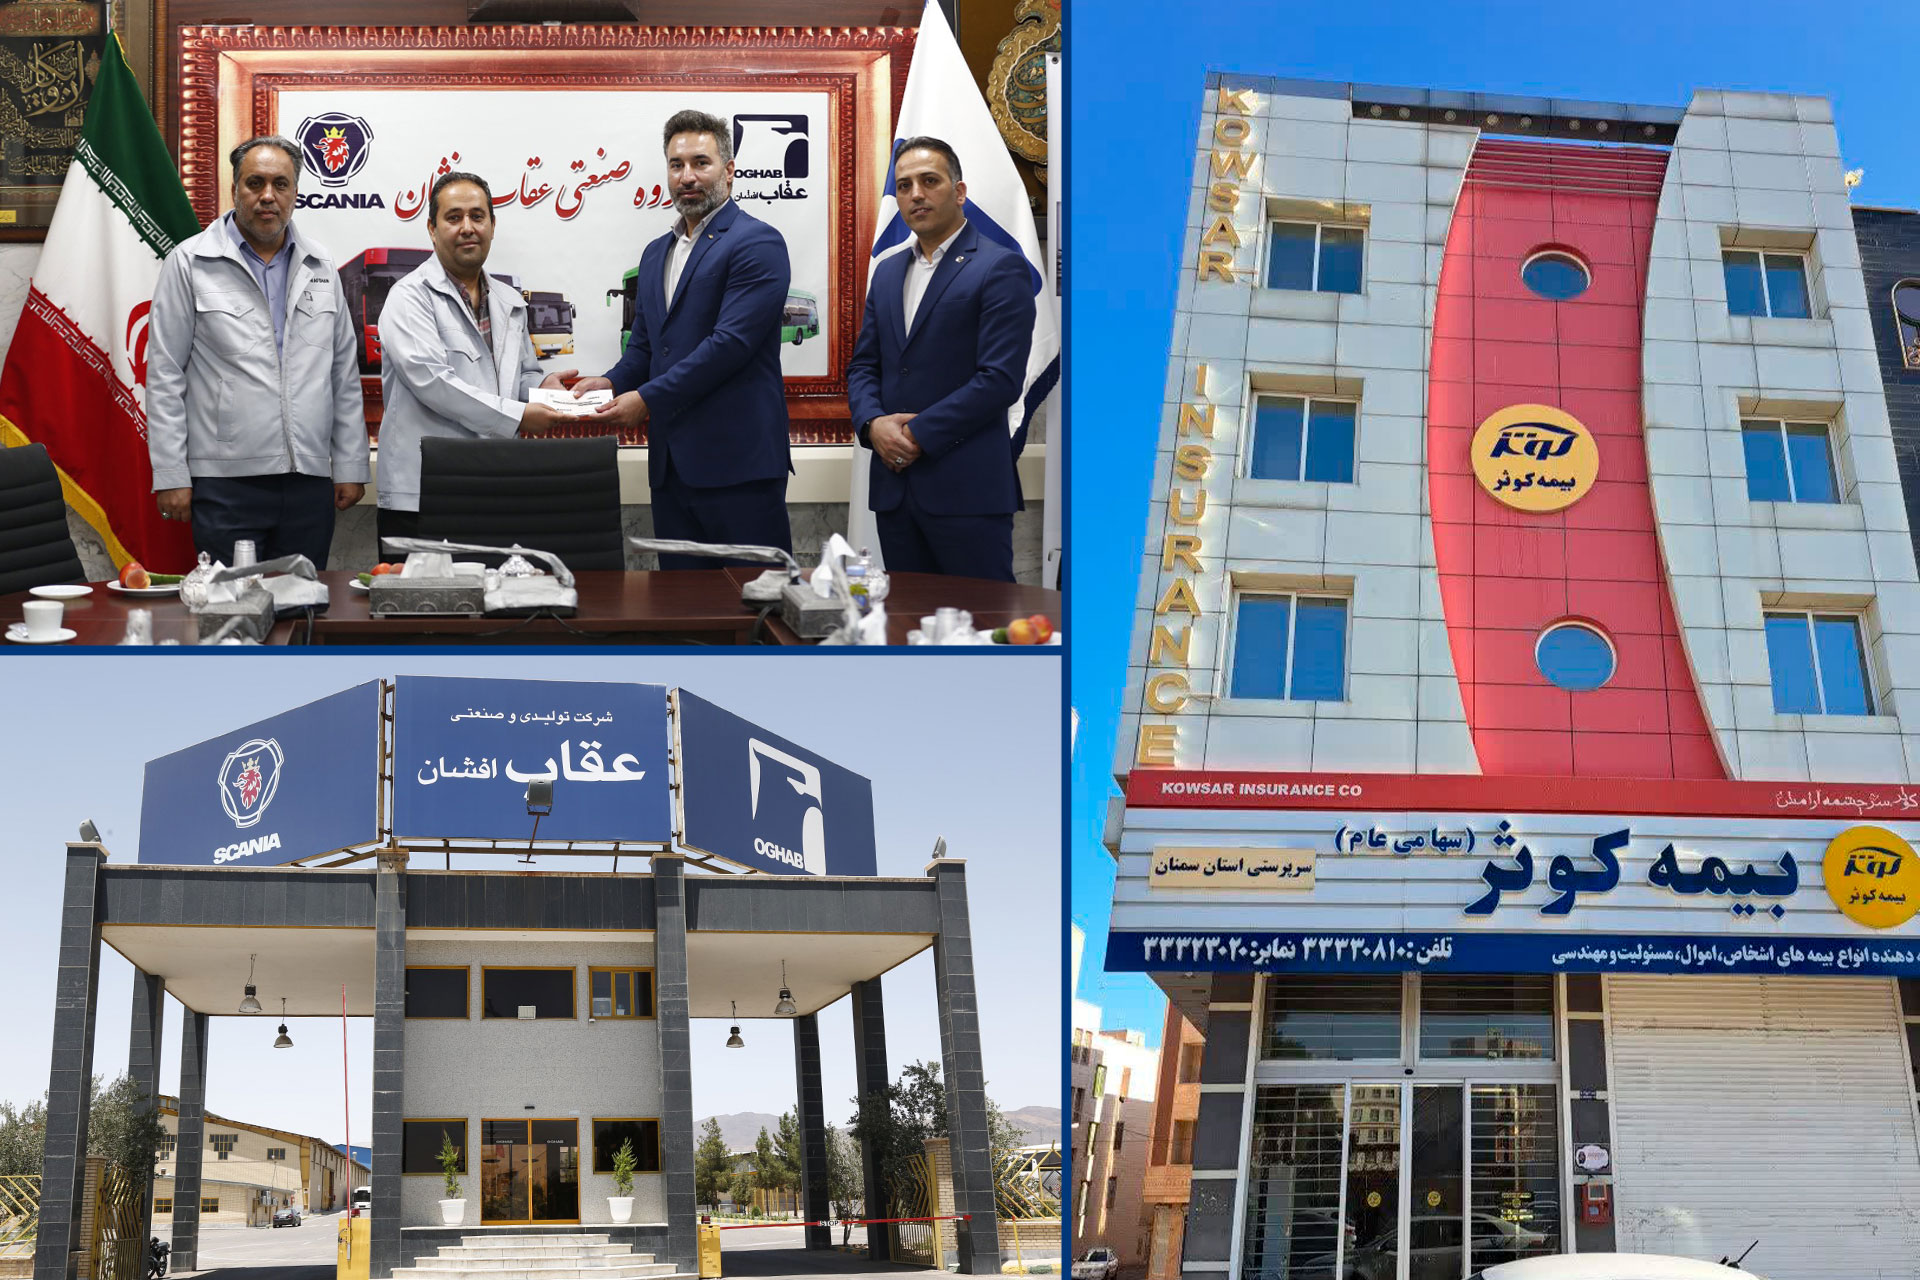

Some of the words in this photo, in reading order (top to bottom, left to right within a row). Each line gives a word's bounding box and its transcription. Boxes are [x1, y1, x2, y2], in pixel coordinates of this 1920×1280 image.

[555, 147, 632, 220] صنعتی
[734, 169, 783, 179] OGHAB
[634, 181, 675, 208] روه
[759, 180, 808, 205] عقاب
[1198, 87, 1258, 283] KOWSAR
[295, 193, 385, 209] SCANIA
[1493, 469, 1536, 492] کوثر
[1537, 473, 1576, 492] بیمه
[1138, 362, 1218, 767] INSURANCE
[450, 708, 504, 723] صنعتی
[507, 712, 517, 724] و
[519, 710, 570, 726] تولیدی
[573, 711, 613, 726] شرکت
[417, 756, 498, 785] افشان
[505, 739, 646, 800] عقاب
[1161, 782, 1234, 796] KOWSAR
[1239, 783, 1335, 797] INSURANCE
[1338, 784, 1362, 797] CO
[213, 831, 281, 865] SCANIA
[753, 836, 805, 870] OGHAB
[1155, 857, 1200, 876] سمنان
[1203, 857, 1244, 876] استان
[1247, 860, 1313, 878] سرپرستی
[1463, 819, 1631, 917] کوثر
[1648, 842, 1800, 920] بیمه
[1848, 887, 1877, 904] کوثر
[1879, 891, 1906, 905] بیمه
[1551, 944, 1607, 964] مهندسی
[1608, 949, 1617, 965] و
[1617, 943, 1674, 966] مسئولیت
[1776, 945, 1805, 967] های
[1807, 949, 1834, 966] بیمه
[1836, 946, 1869, 968] انواع
[1872, 948, 1914, 963] دهنده
